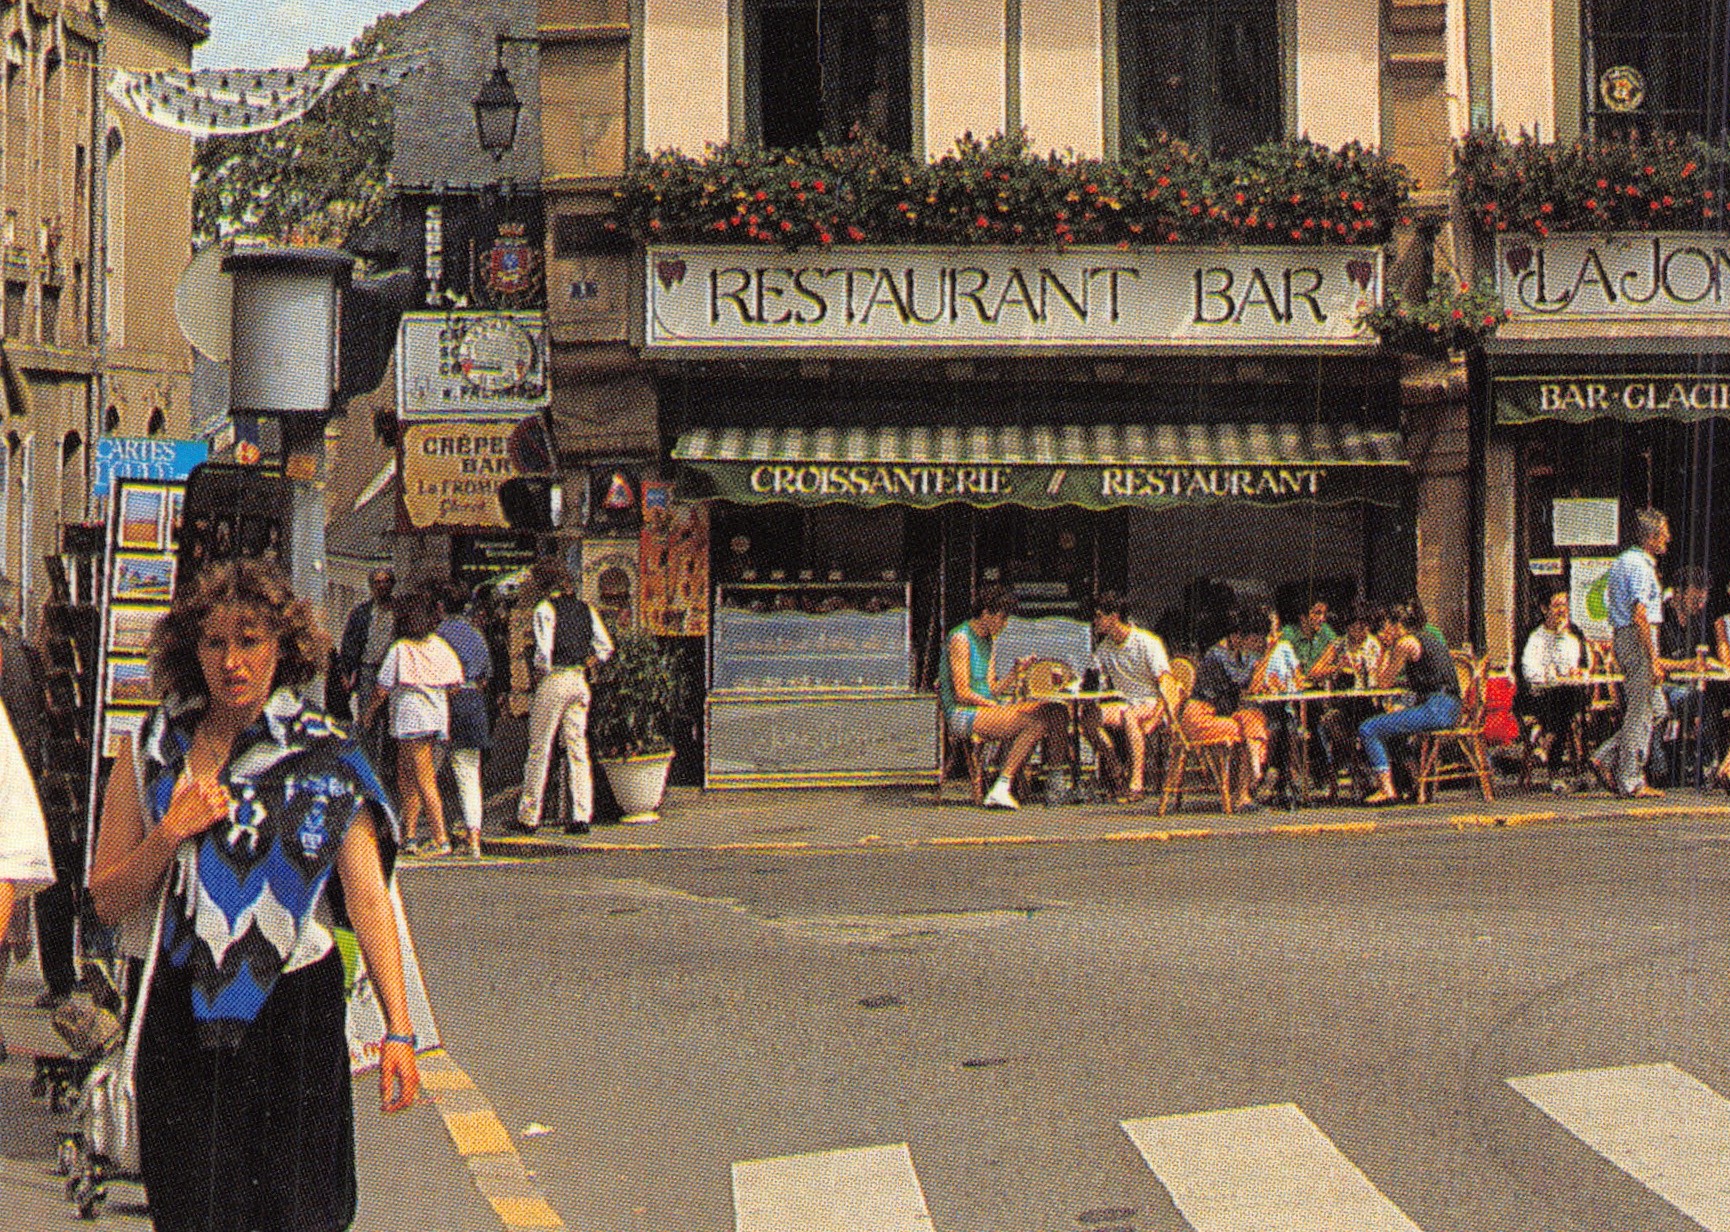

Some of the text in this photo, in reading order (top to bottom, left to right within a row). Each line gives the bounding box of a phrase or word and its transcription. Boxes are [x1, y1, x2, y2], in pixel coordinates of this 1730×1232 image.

[709, 266, 1328, 327] RESTAURANT BAR
[1539, 384, 1607, 412] BAR
[422, 433, 511, 456] CRÊPE
[462, 457, 512, 475] BAR
[751, 467, 1012, 497] CROISSANTERIE
[1101, 468, 1329, 497] RESTAURANT
